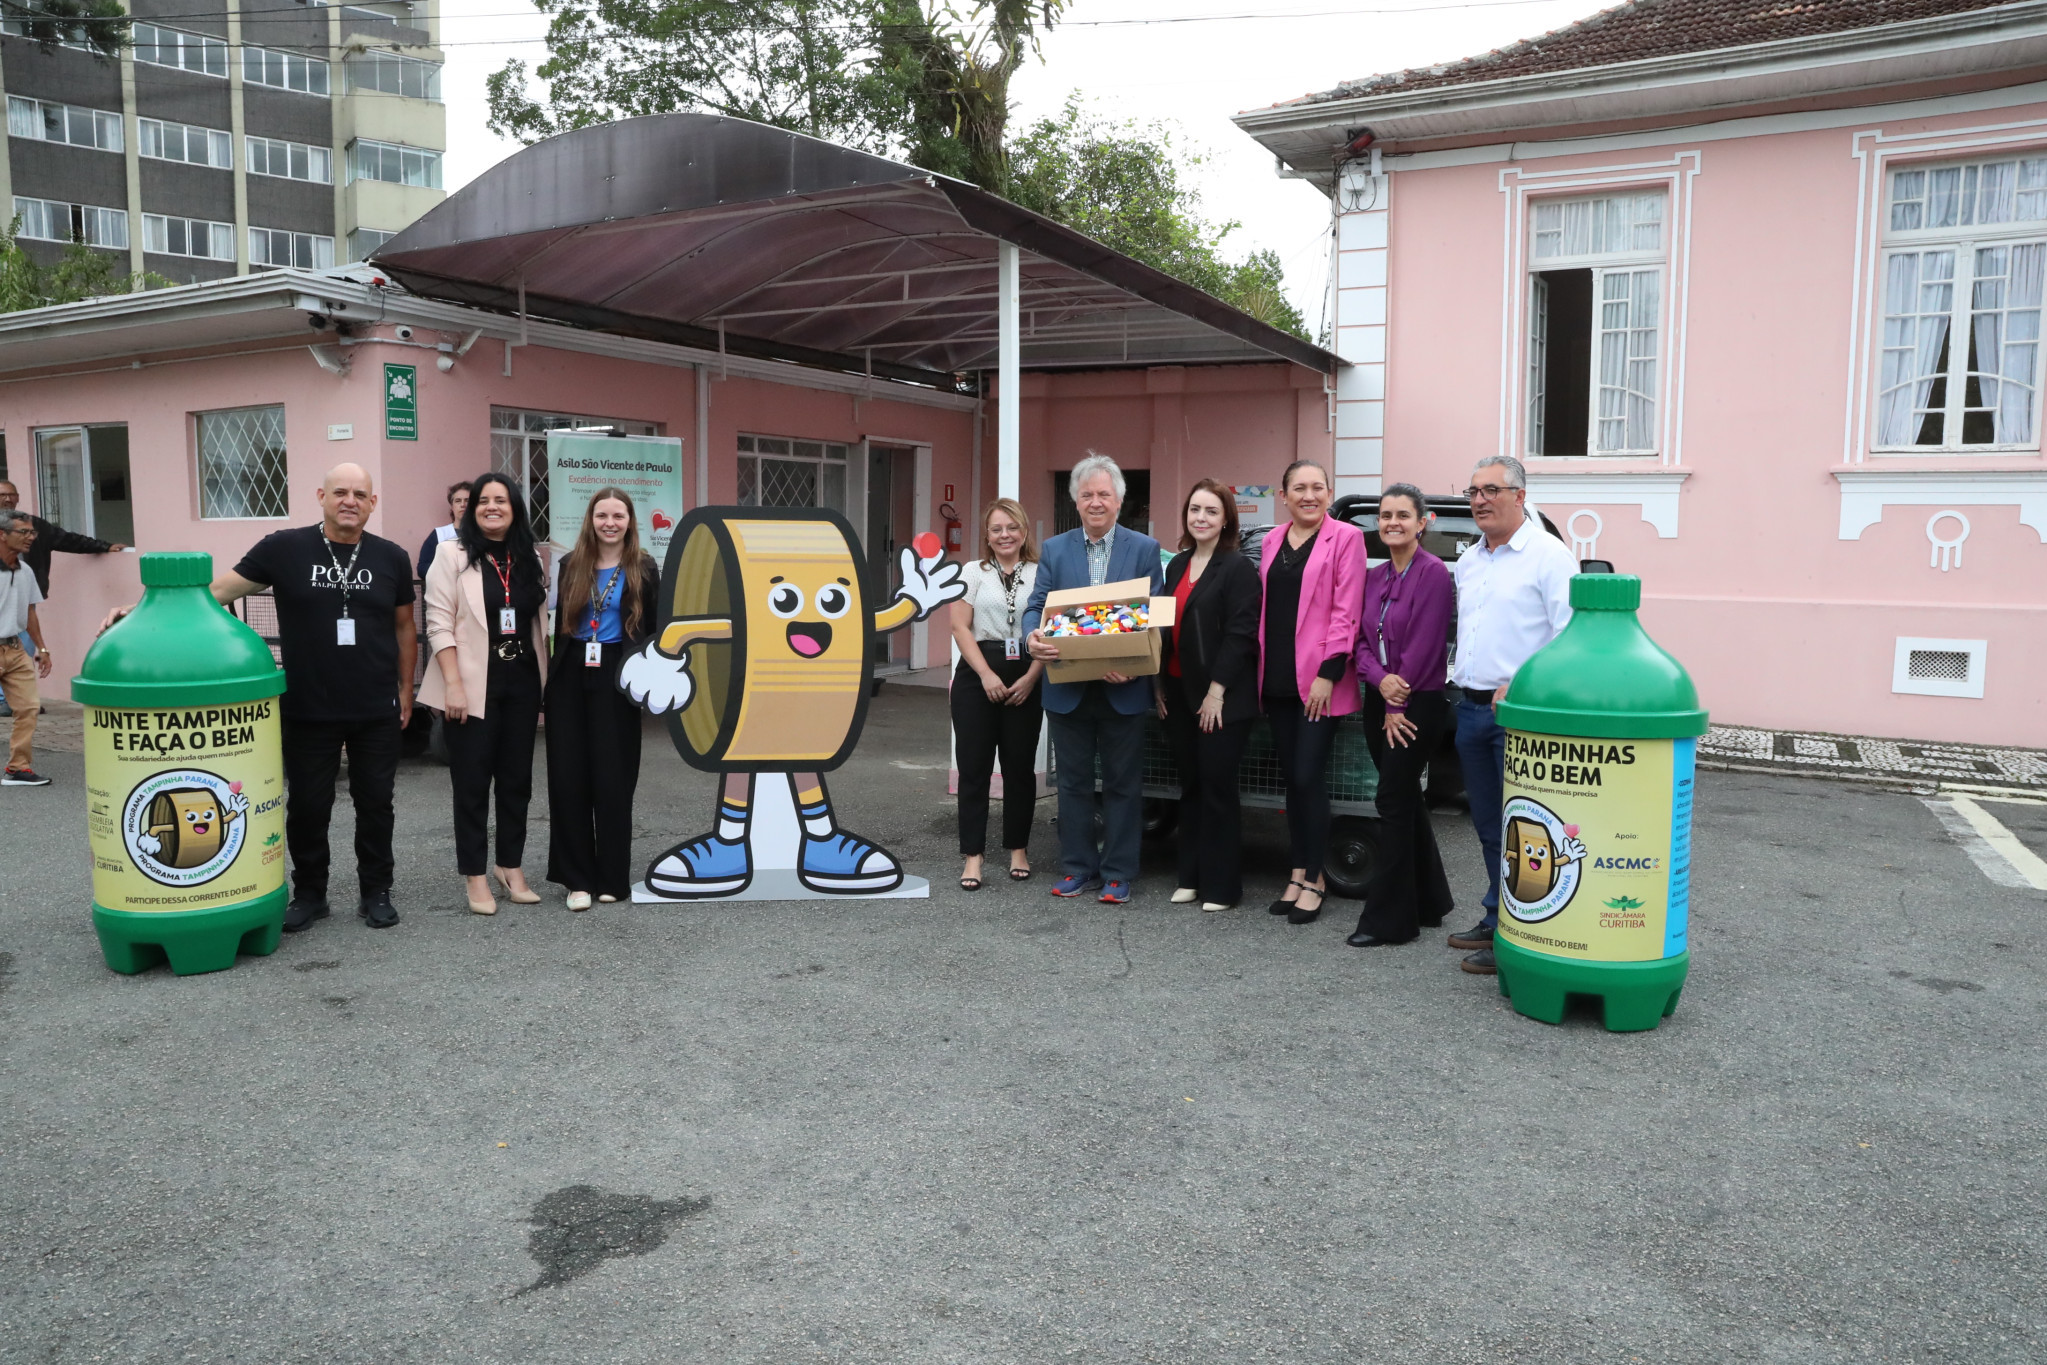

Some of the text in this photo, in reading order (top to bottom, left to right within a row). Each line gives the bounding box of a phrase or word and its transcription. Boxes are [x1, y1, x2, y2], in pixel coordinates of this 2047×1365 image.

[557, 458, 673, 473] Asilo São Vicente de Paulo
[568, 474, 663, 487] Excelência no atendimento
[309, 564, 373, 585] POLO
[311, 581, 337, 589] RALPH
[93, 701, 271, 731] JUNTE TAMPINHAS
[113, 725, 255, 756] E FAÇA O BEM
[176, 755, 197, 763] ajuda
[197, 753, 218, 762] quem
[218, 750, 234, 758] mais
[234, 747, 253, 757] precisa
[1514, 735, 1636, 765] TAMPINHAS
[1533, 761, 1546, 781] O
[1550, 764, 1602, 786] BEM
[1537, 786, 1555, 794] quem
[1555, 788, 1571, 796] mais
[1572, 790, 1598, 798] precisa
[129, 775, 220, 833] PROGRAMA TAMPINHA PARANÁ
[1527, 805, 1554, 827] PARANÁ
[1614, 832, 1639, 840] Apoio:
[138, 826, 240, 881] PROGRAMA TAMPINHA PARANÁ
[96, 861, 124, 873] CURITIBA
[1593, 856, 1652, 870] ASCMC
[125, 896, 160, 905] PARTICIPE
[161, 896, 188, 905] DESSA
[188, 891, 230, 903] CORRENTE
[230, 888, 241, 898] DO
[1518, 902, 1553, 915] TAMPINHA
[1551, 874, 1572, 905] PARANÁ
[1599, 911, 1646, 919] SINDICÂMARA
[1599, 918, 1646, 928] CURITIBA
[1520, 931, 1554, 946] CORRENTE
[1554, 940, 1567, 949] DO
[1567, 941, 1588, 951] BEM!
